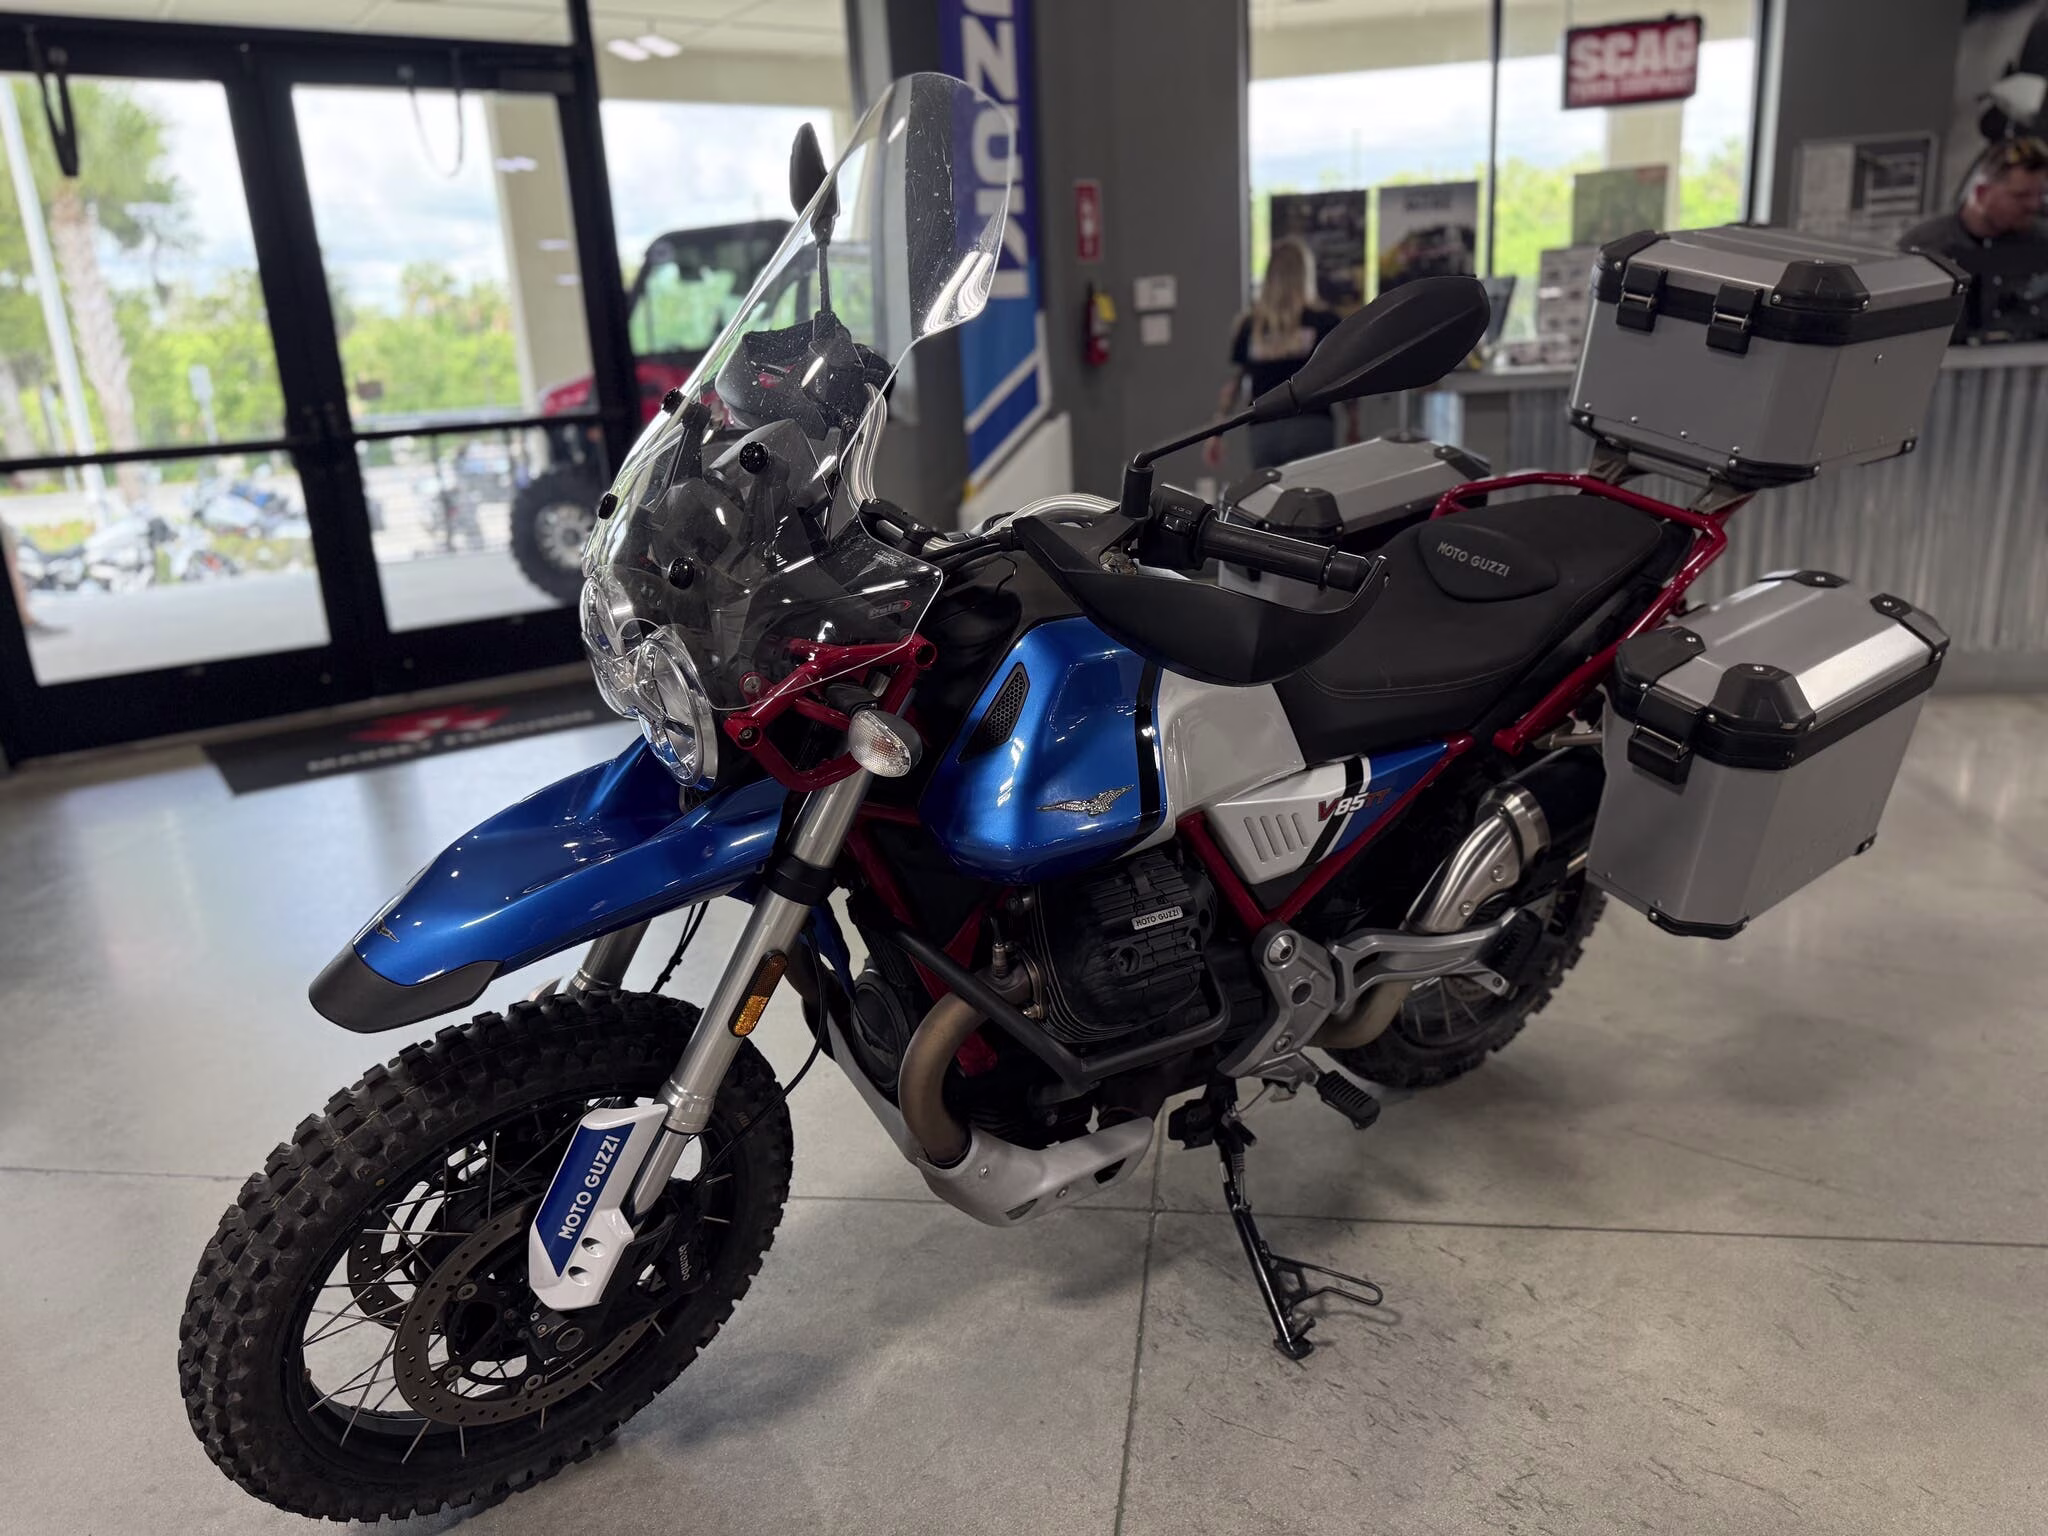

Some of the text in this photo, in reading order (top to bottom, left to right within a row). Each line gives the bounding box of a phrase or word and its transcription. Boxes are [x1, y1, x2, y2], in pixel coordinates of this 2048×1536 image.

[1570, 24, 1697, 80] SCAG
[960, 0, 1029, 298] ZUKI
[1437, 541, 1510, 577] MOTO GUZZI
[1135, 908, 1180, 927] MOTO GUZZI
[558, 1134, 621, 1240] MOTO GUZZI
[678, 1241, 692, 1281] brembo
